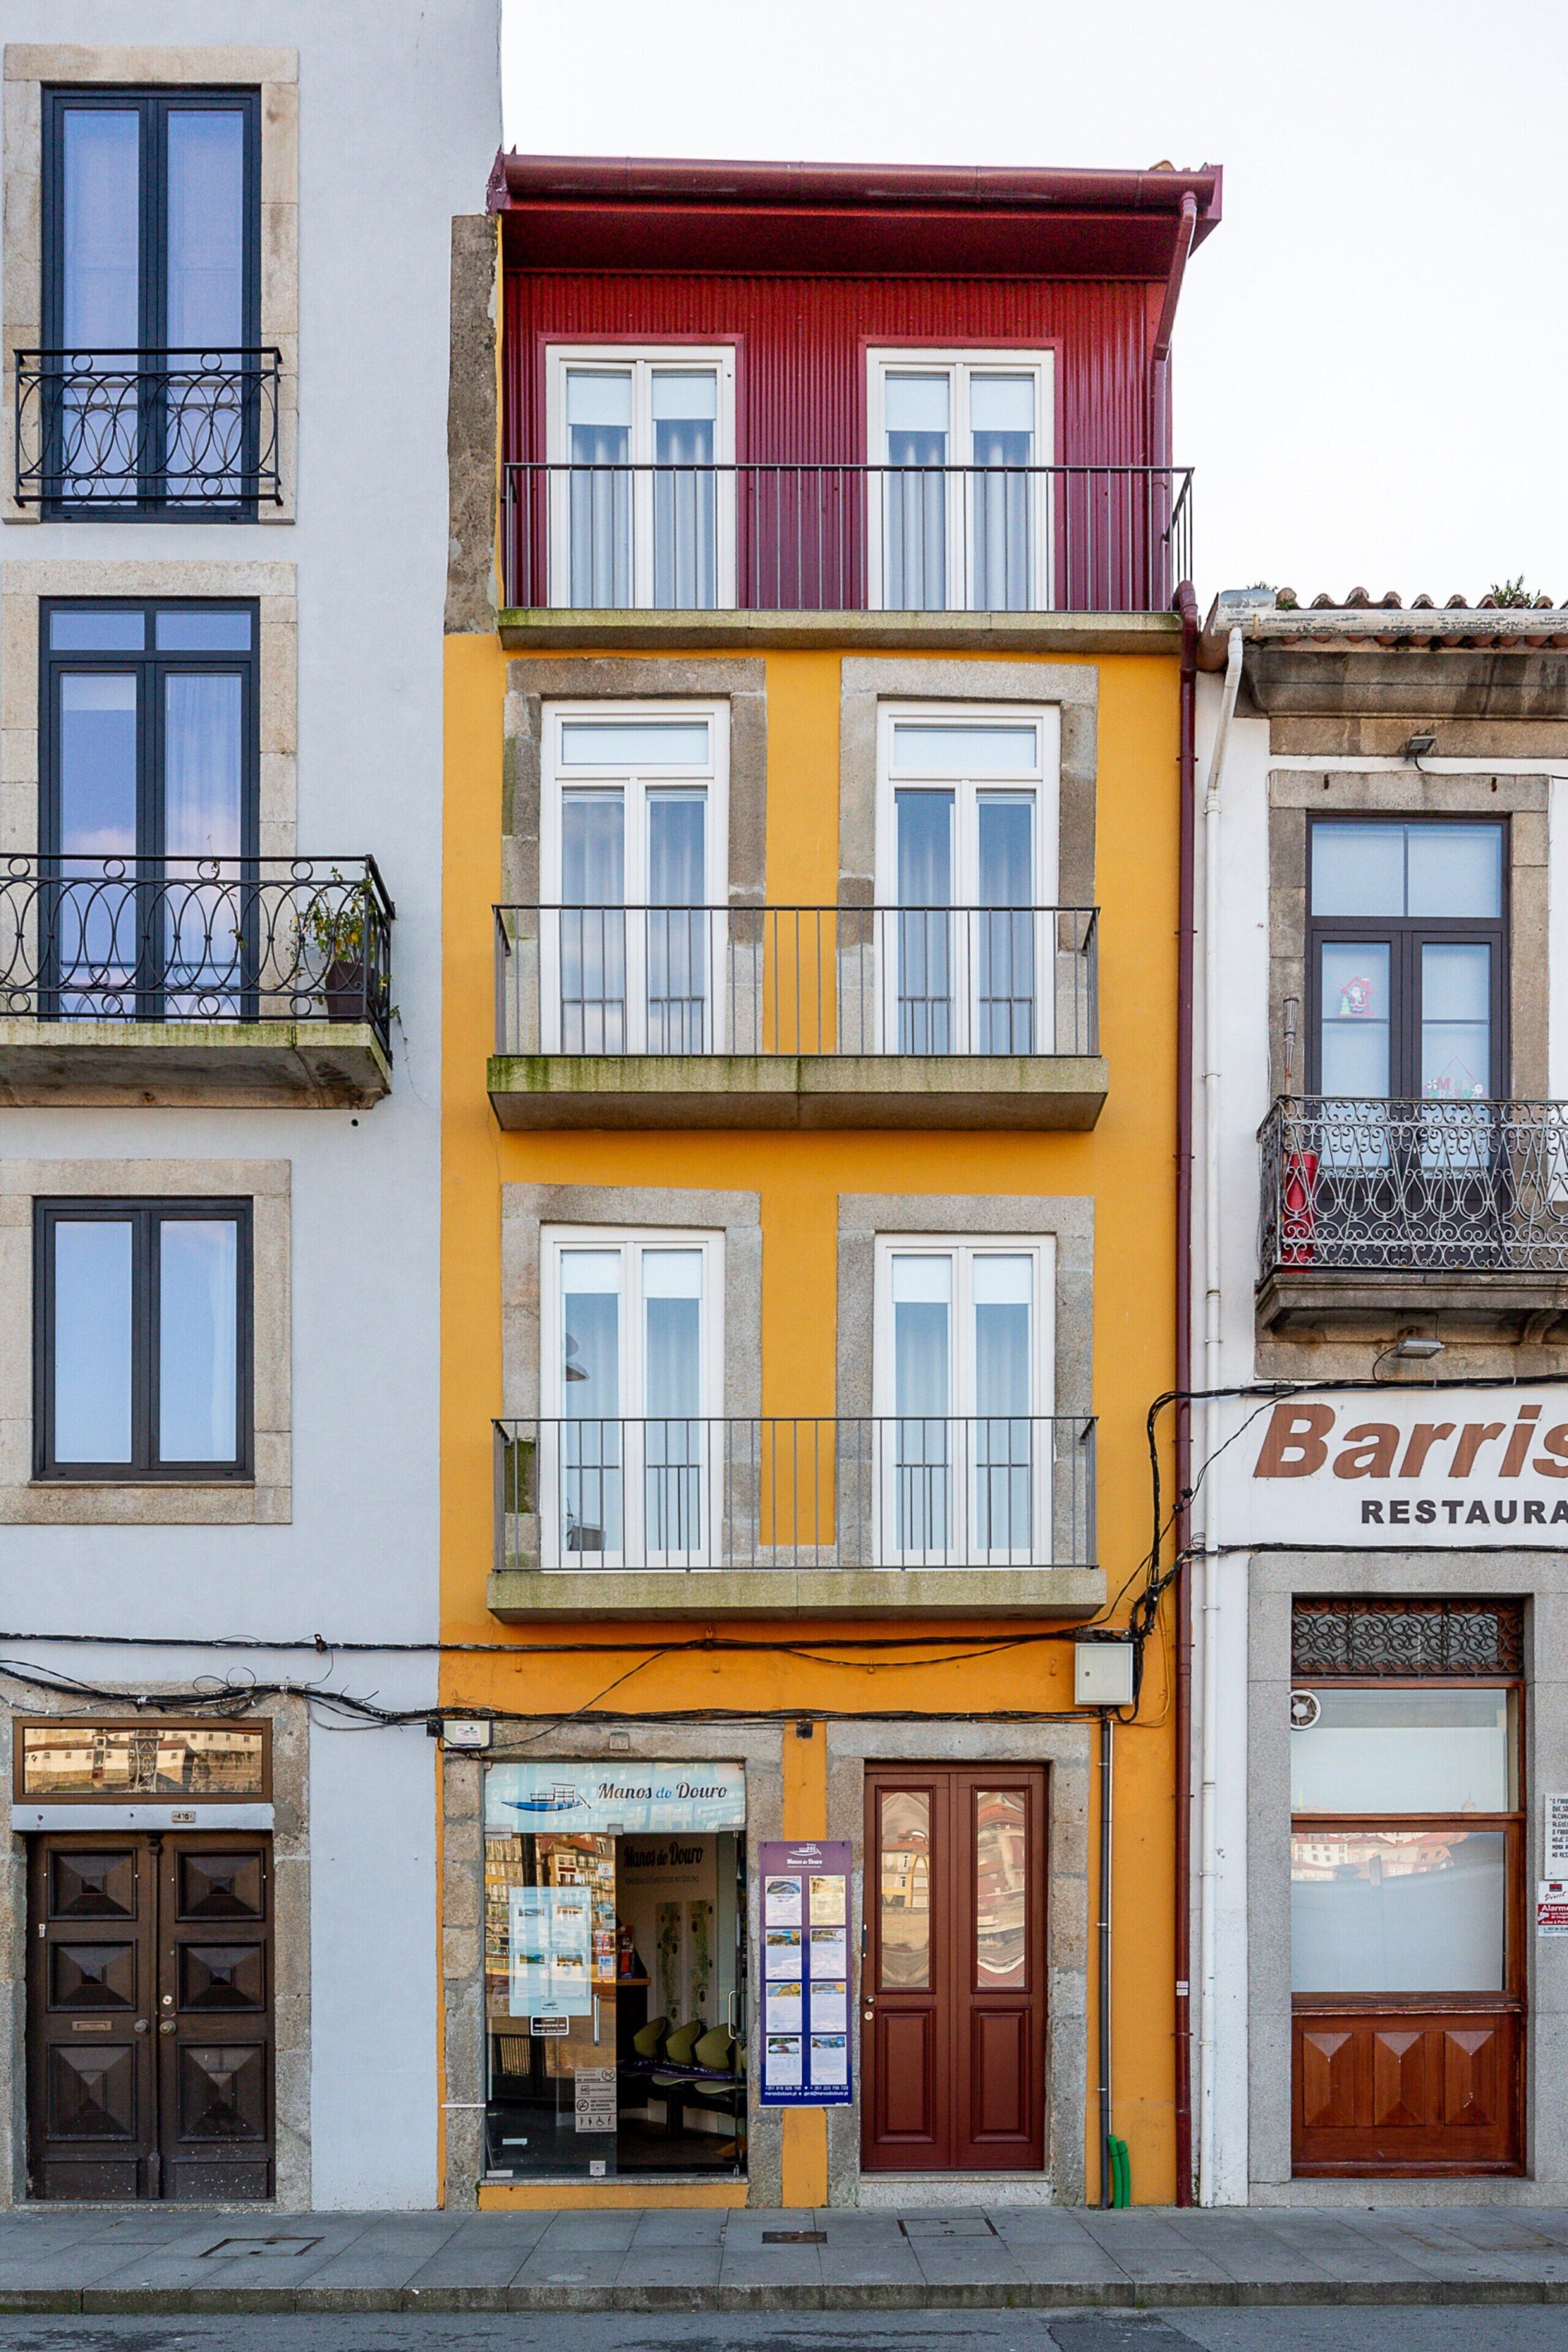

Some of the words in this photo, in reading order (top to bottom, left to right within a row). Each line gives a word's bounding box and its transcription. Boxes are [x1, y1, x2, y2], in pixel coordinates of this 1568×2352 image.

[1362, 1500, 1568, 1524] RESTAURA
[598, 1783, 652, 1799] Manos
[656, 1787, 672, 1799] do
[676, 1782, 728, 1799] Douro
[624, 1845, 655, 1868] Manos
[669, 1841, 704, 1865] Douro
